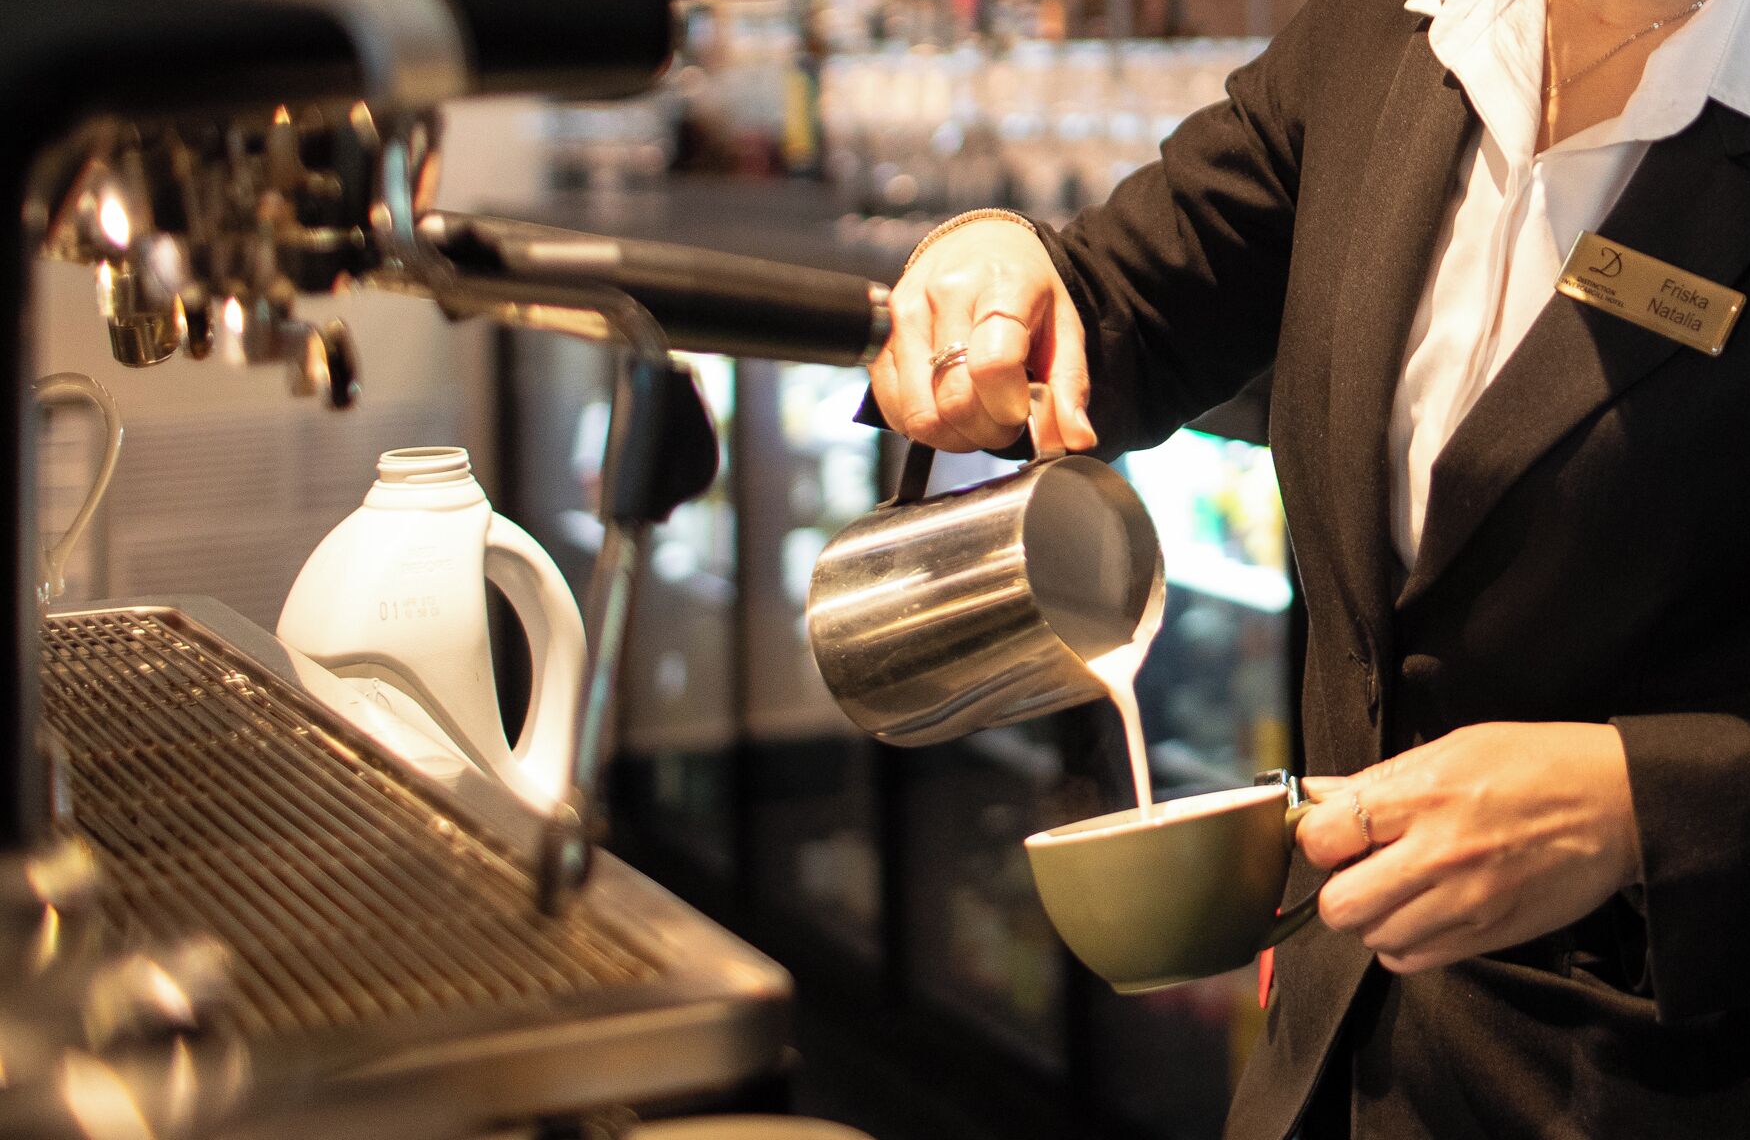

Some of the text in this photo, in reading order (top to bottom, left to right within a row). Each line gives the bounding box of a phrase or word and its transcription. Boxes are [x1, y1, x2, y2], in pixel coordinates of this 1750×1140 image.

[1576, 275, 1617, 296] DISTINCTION
[1660, 278, 1709, 309] Friska
[1647, 297, 1703, 332] Natalia
